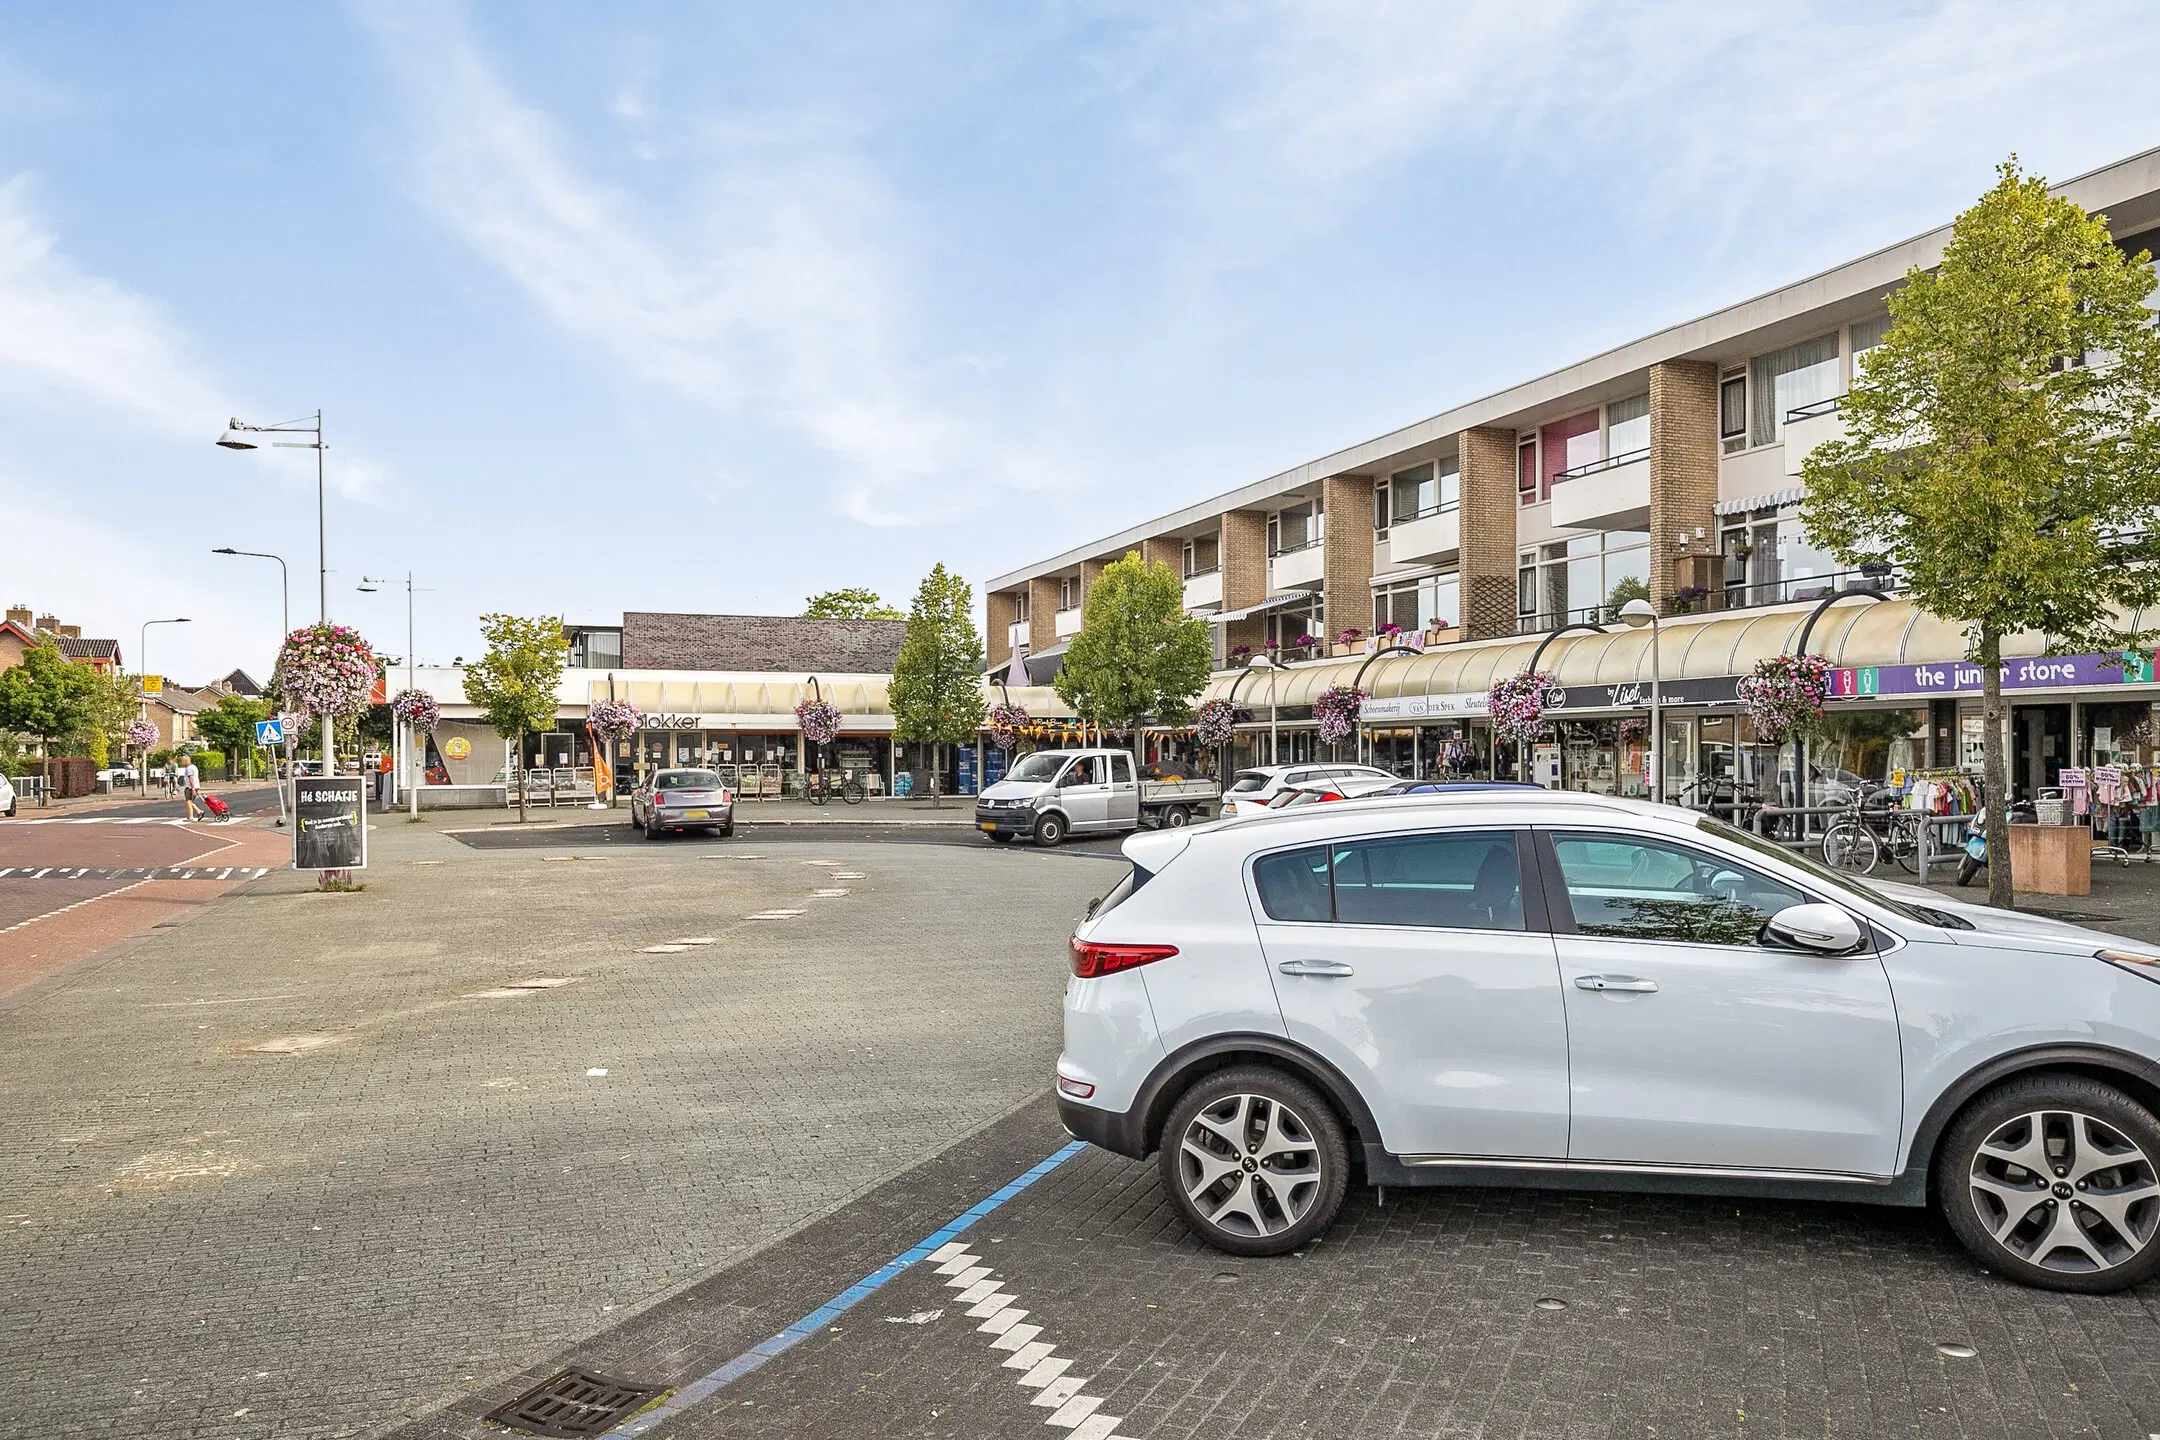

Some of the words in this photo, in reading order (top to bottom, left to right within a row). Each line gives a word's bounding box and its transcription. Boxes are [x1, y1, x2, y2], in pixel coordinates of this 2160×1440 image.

[1915, 665, 1945, 686] the
[1954, 663, 2010, 690] junr
[2020, 661, 2076, 682] store
[1612, 683, 1641, 706] Liset
[1639, 696, 1661, 704] fashn
[1363, 702, 1401, 716] Schoenmakerij
[300, 790, 313, 803] Hé
[315, 790, 358, 803] SCHATJE
[2053, 1185, 2071, 1197] KIA
